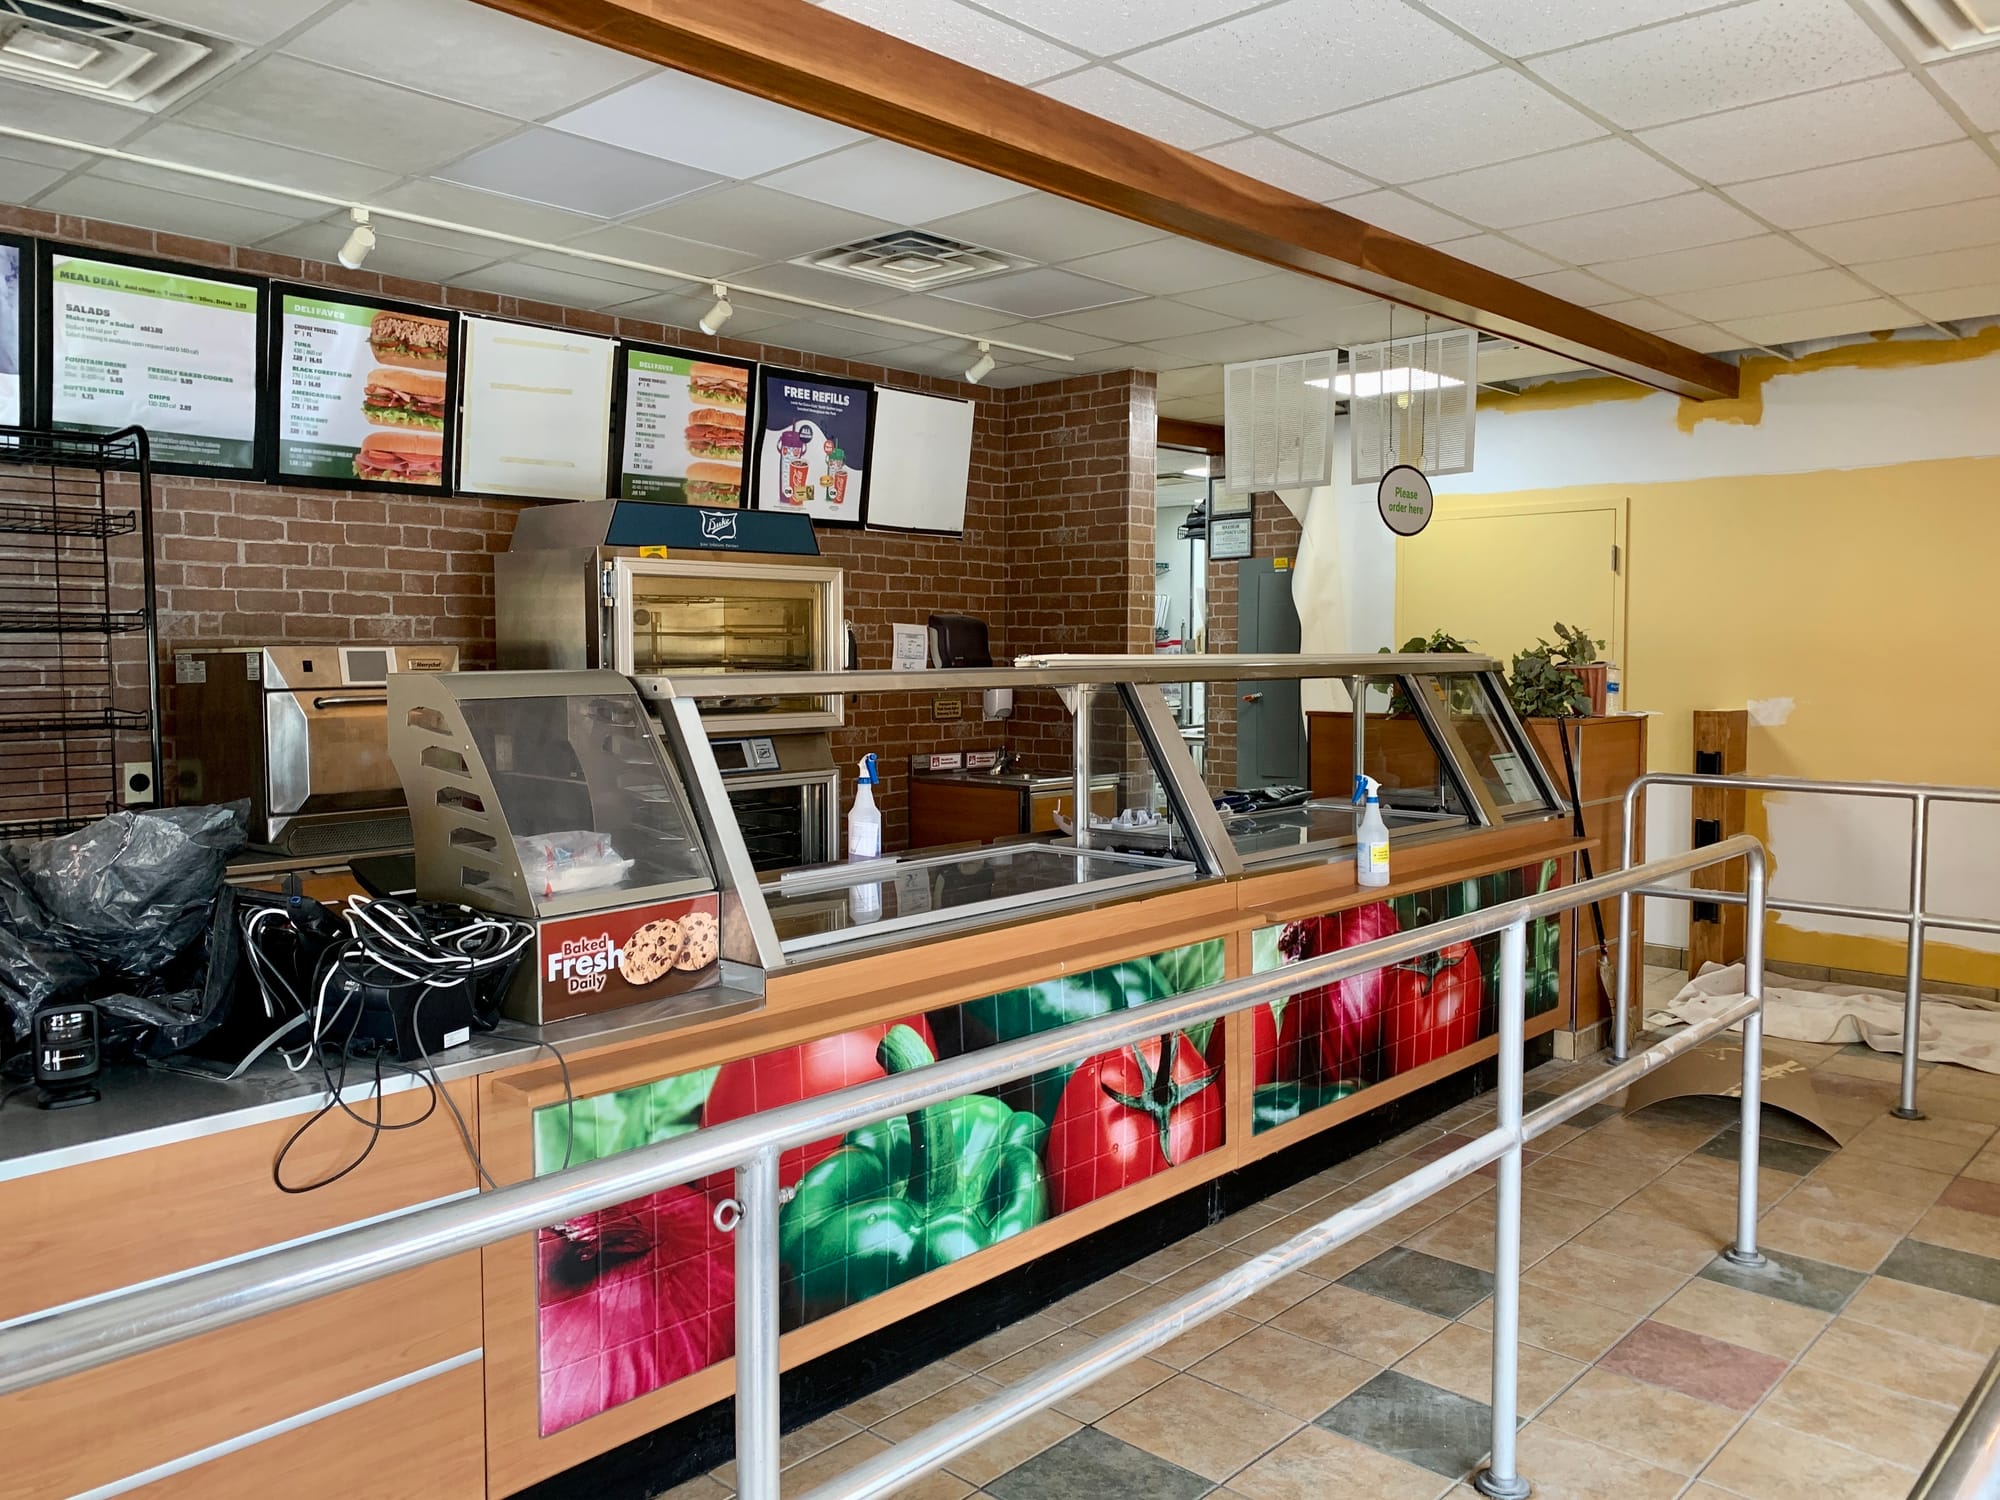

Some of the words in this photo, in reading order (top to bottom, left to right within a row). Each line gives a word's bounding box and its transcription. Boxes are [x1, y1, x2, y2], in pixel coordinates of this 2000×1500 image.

[60, 271, 91, 283] MEAL
[93, 277, 121, 288] DEAL
[65, 303, 111, 317] SALADS
[294, 304, 315, 315] DELI
[316, 308, 345, 320] FAVES
[65, 356, 103, 366] FOUNTAIN
[147, 366, 178, 375] FRESHLY
[203, 374, 233, 383] COOKIES
[292, 366, 313, 374] BLACK
[98, 387, 125, 396] WATER
[148, 393, 171, 401] CHIPS
[784, 385, 811, 400] FREE
[812, 390, 850, 407] REFILLS
[1394, 486, 1418, 500] Please
[1388, 501, 1408, 513] order
[1408, 503, 1424, 515] here
[706, 517, 733, 534] Duke
[563, 934, 608, 956] Baked
[547, 939, 625, 983] Fresh
[569, 974, 606, 993] Daily
